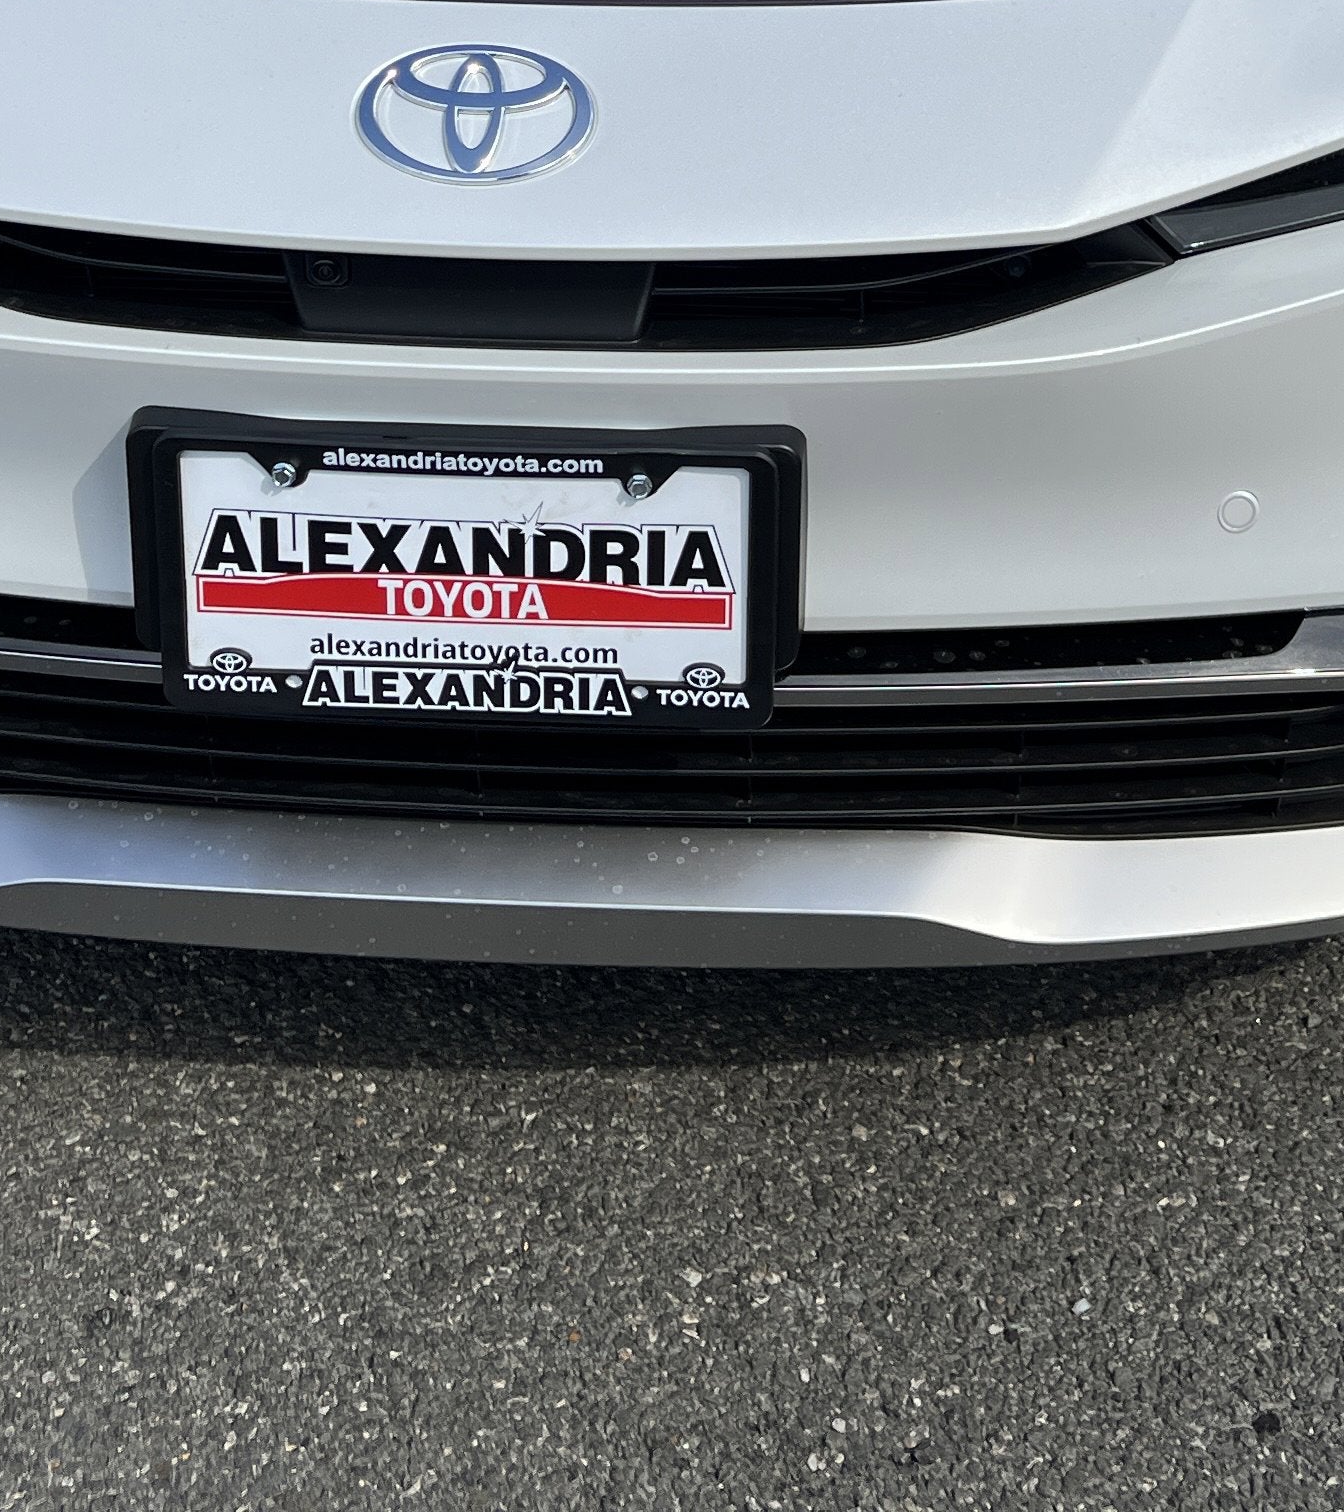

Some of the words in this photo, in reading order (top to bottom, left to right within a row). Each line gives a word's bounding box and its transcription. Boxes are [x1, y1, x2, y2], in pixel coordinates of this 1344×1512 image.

[322, 448, 604, 477] alexandriatoyota.com
[199, 513, 728, 588] ALEXANDRIA
[377, 578, 549, 620] TOYOTA
[309, 633, 619, 666] alexandriatoyota.com
[183, 673, 278, 693] TOYOTA
[303, 666, 632, 716] ALEXANDRIA
[656, 688, 750, 709] TOYOTA
